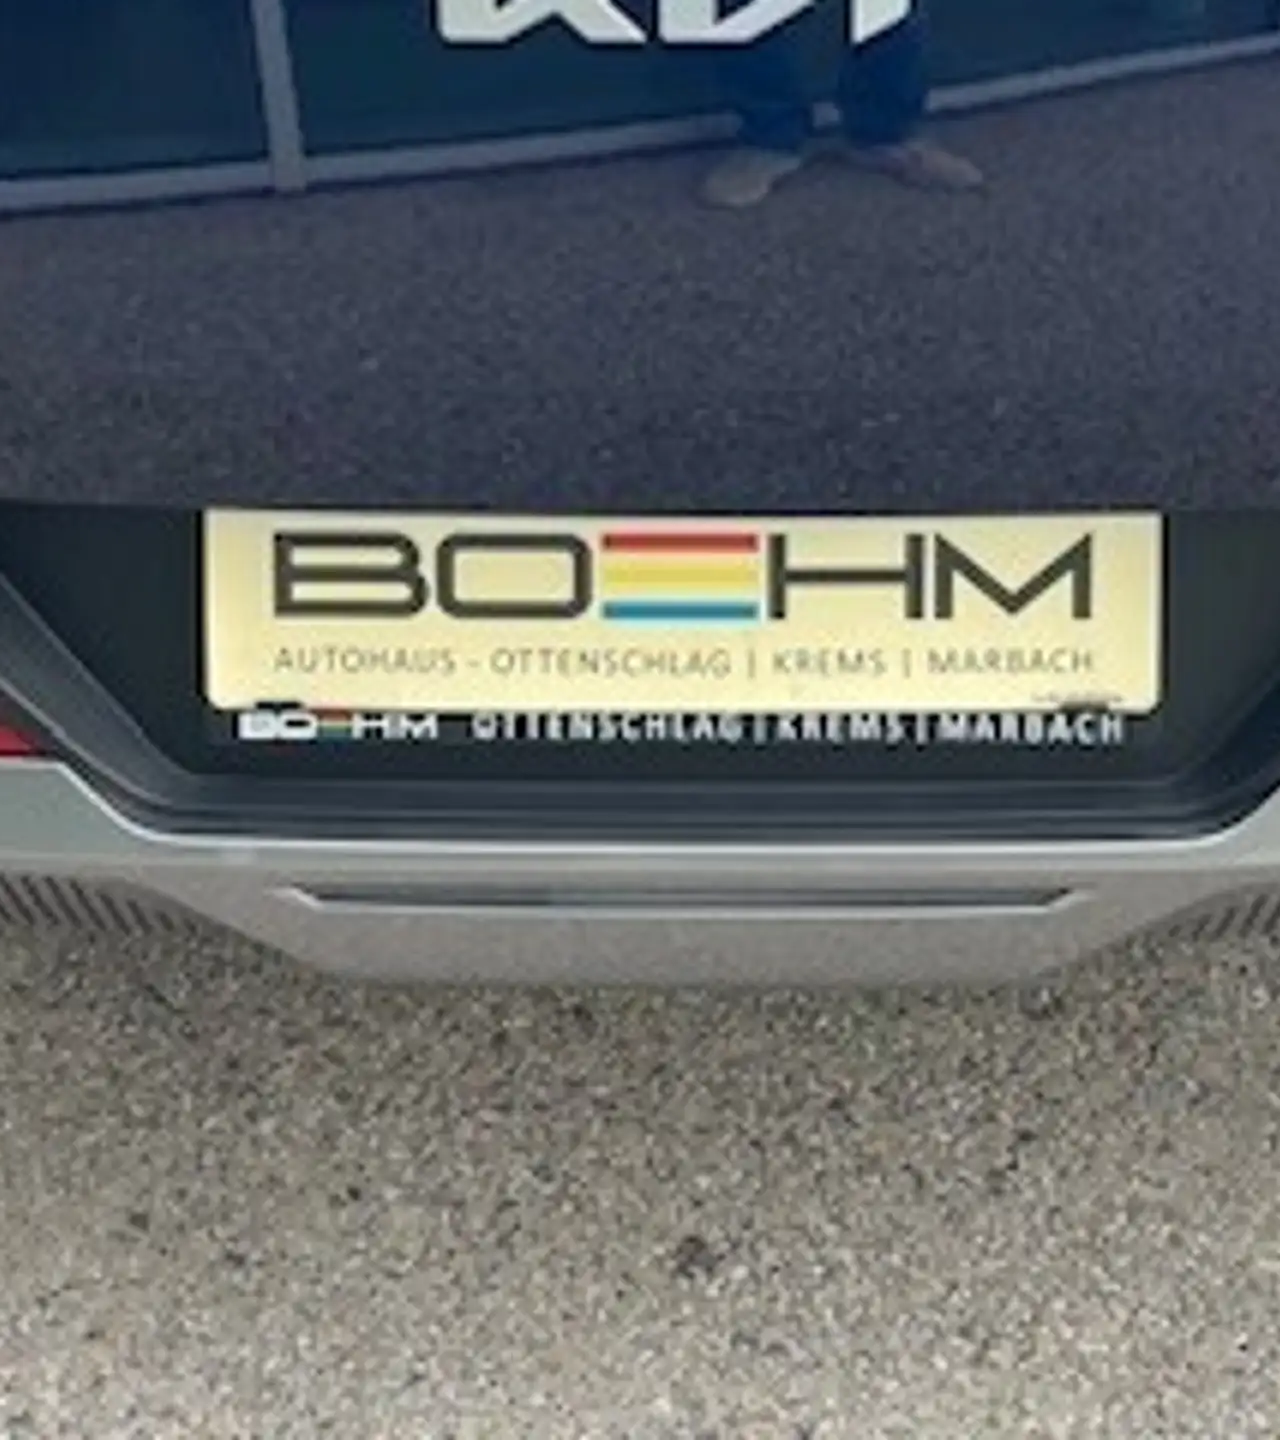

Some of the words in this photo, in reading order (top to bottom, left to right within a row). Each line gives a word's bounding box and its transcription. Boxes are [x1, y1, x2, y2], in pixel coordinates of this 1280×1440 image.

[273, 532, 1093, 621] BOEHM
[273, 646, 458, 676] AUTOHAUS
[489, 647, 732, 678] OTTENSCHLAG
[772, 647, 887, 676] KREMS
[927, 647, 1094, 676] MARBACH
